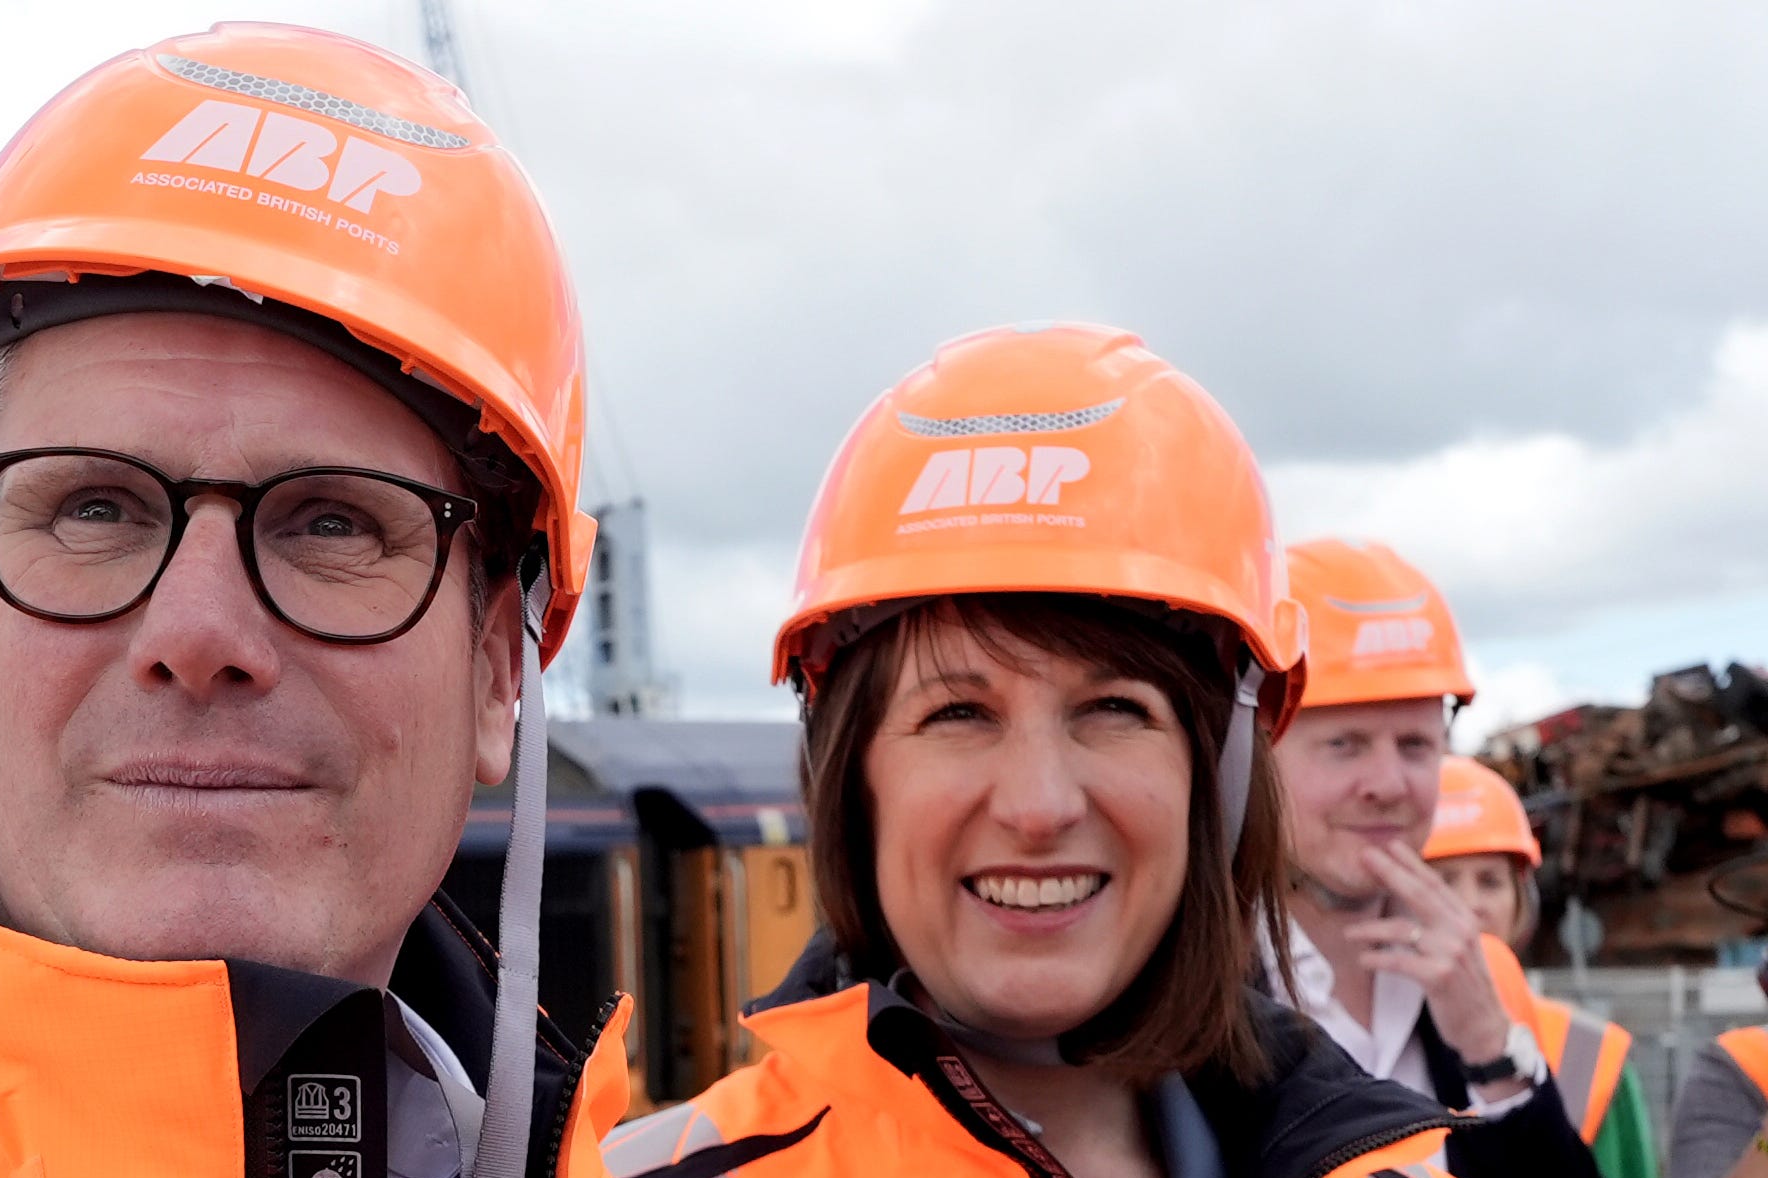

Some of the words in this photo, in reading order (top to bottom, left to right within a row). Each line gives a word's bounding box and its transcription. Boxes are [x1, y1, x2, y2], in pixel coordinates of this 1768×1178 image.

[139, 99, 422, 214] ABP
[130, 171, 253, 202] ASSOCIATED
[257, 192, 332, 226] BRITISH
[335, 217, 400, 256] PORTS
[899, 446, 1090, 515] ABP
[333, 1086, 352, 1121] 3
